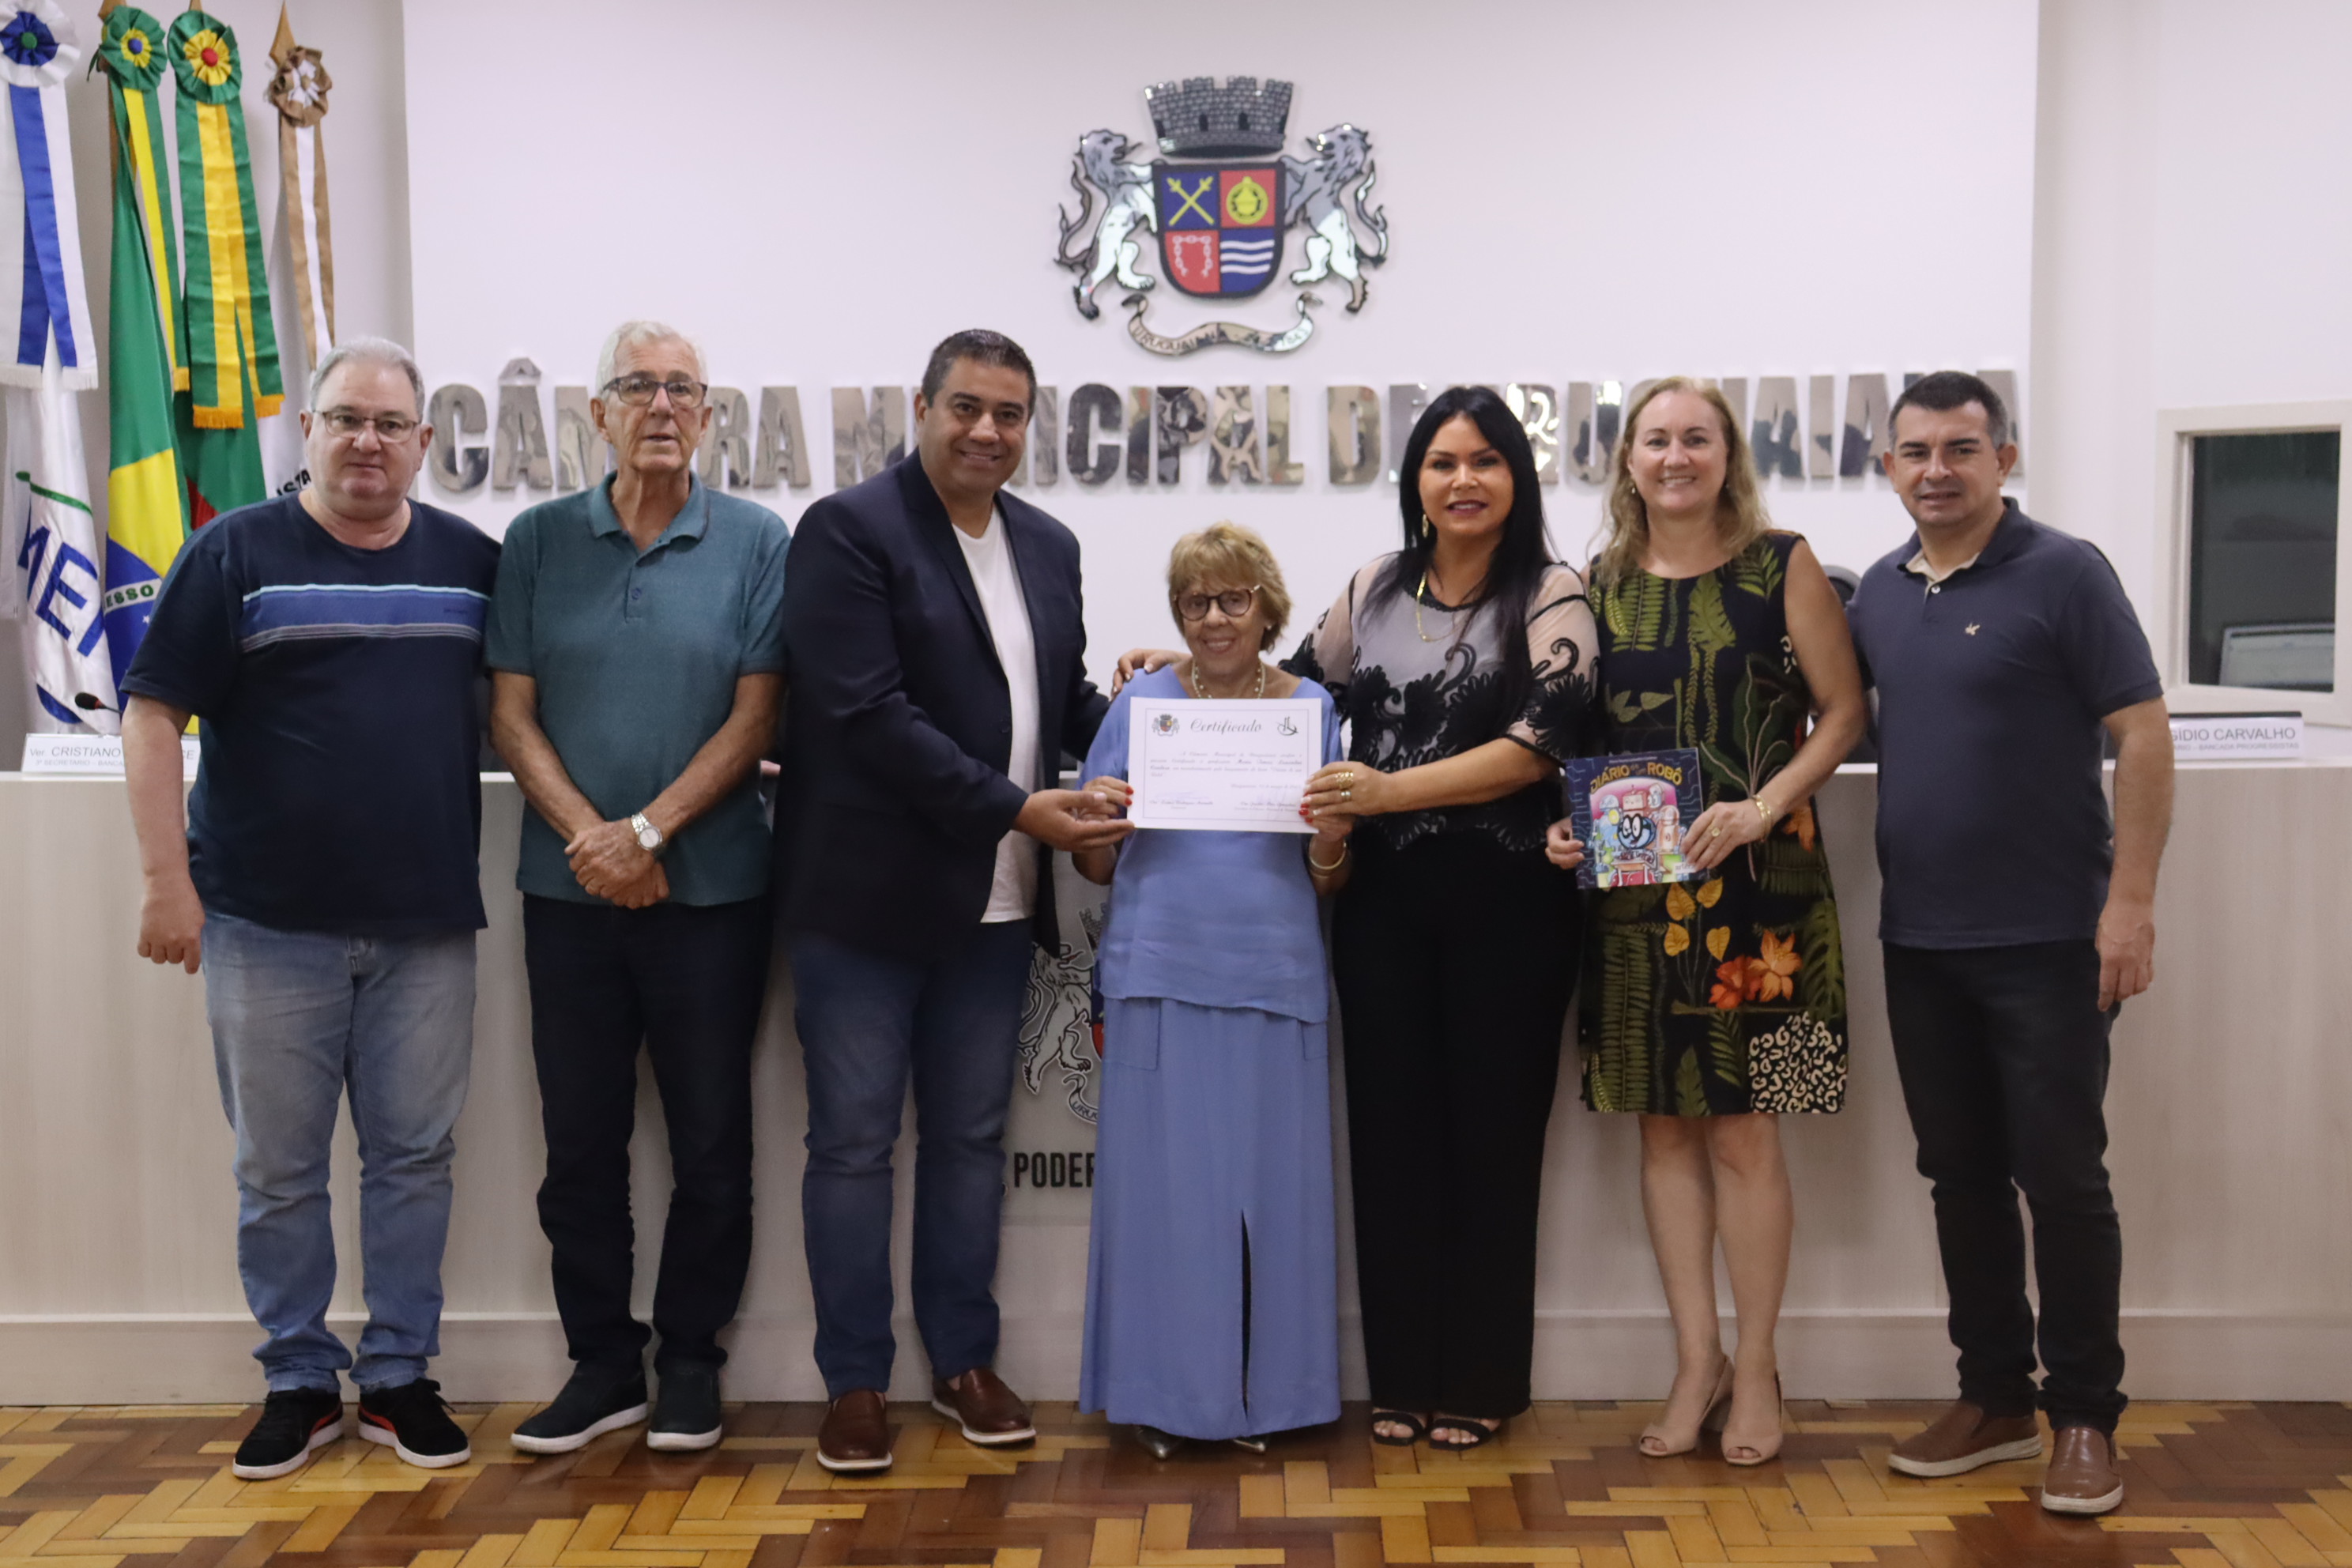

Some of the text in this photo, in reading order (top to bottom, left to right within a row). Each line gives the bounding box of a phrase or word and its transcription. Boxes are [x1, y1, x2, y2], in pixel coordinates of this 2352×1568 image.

[428, 357, 812, 491] CÂMRA
[1189, 717, 1262, 736] Certificado
[2214, 726, 2296, 741] CARVALHO
[51, 746, 122, 758] CRISTIANO
[1647, 761, 1683, 786] ROBÔ
